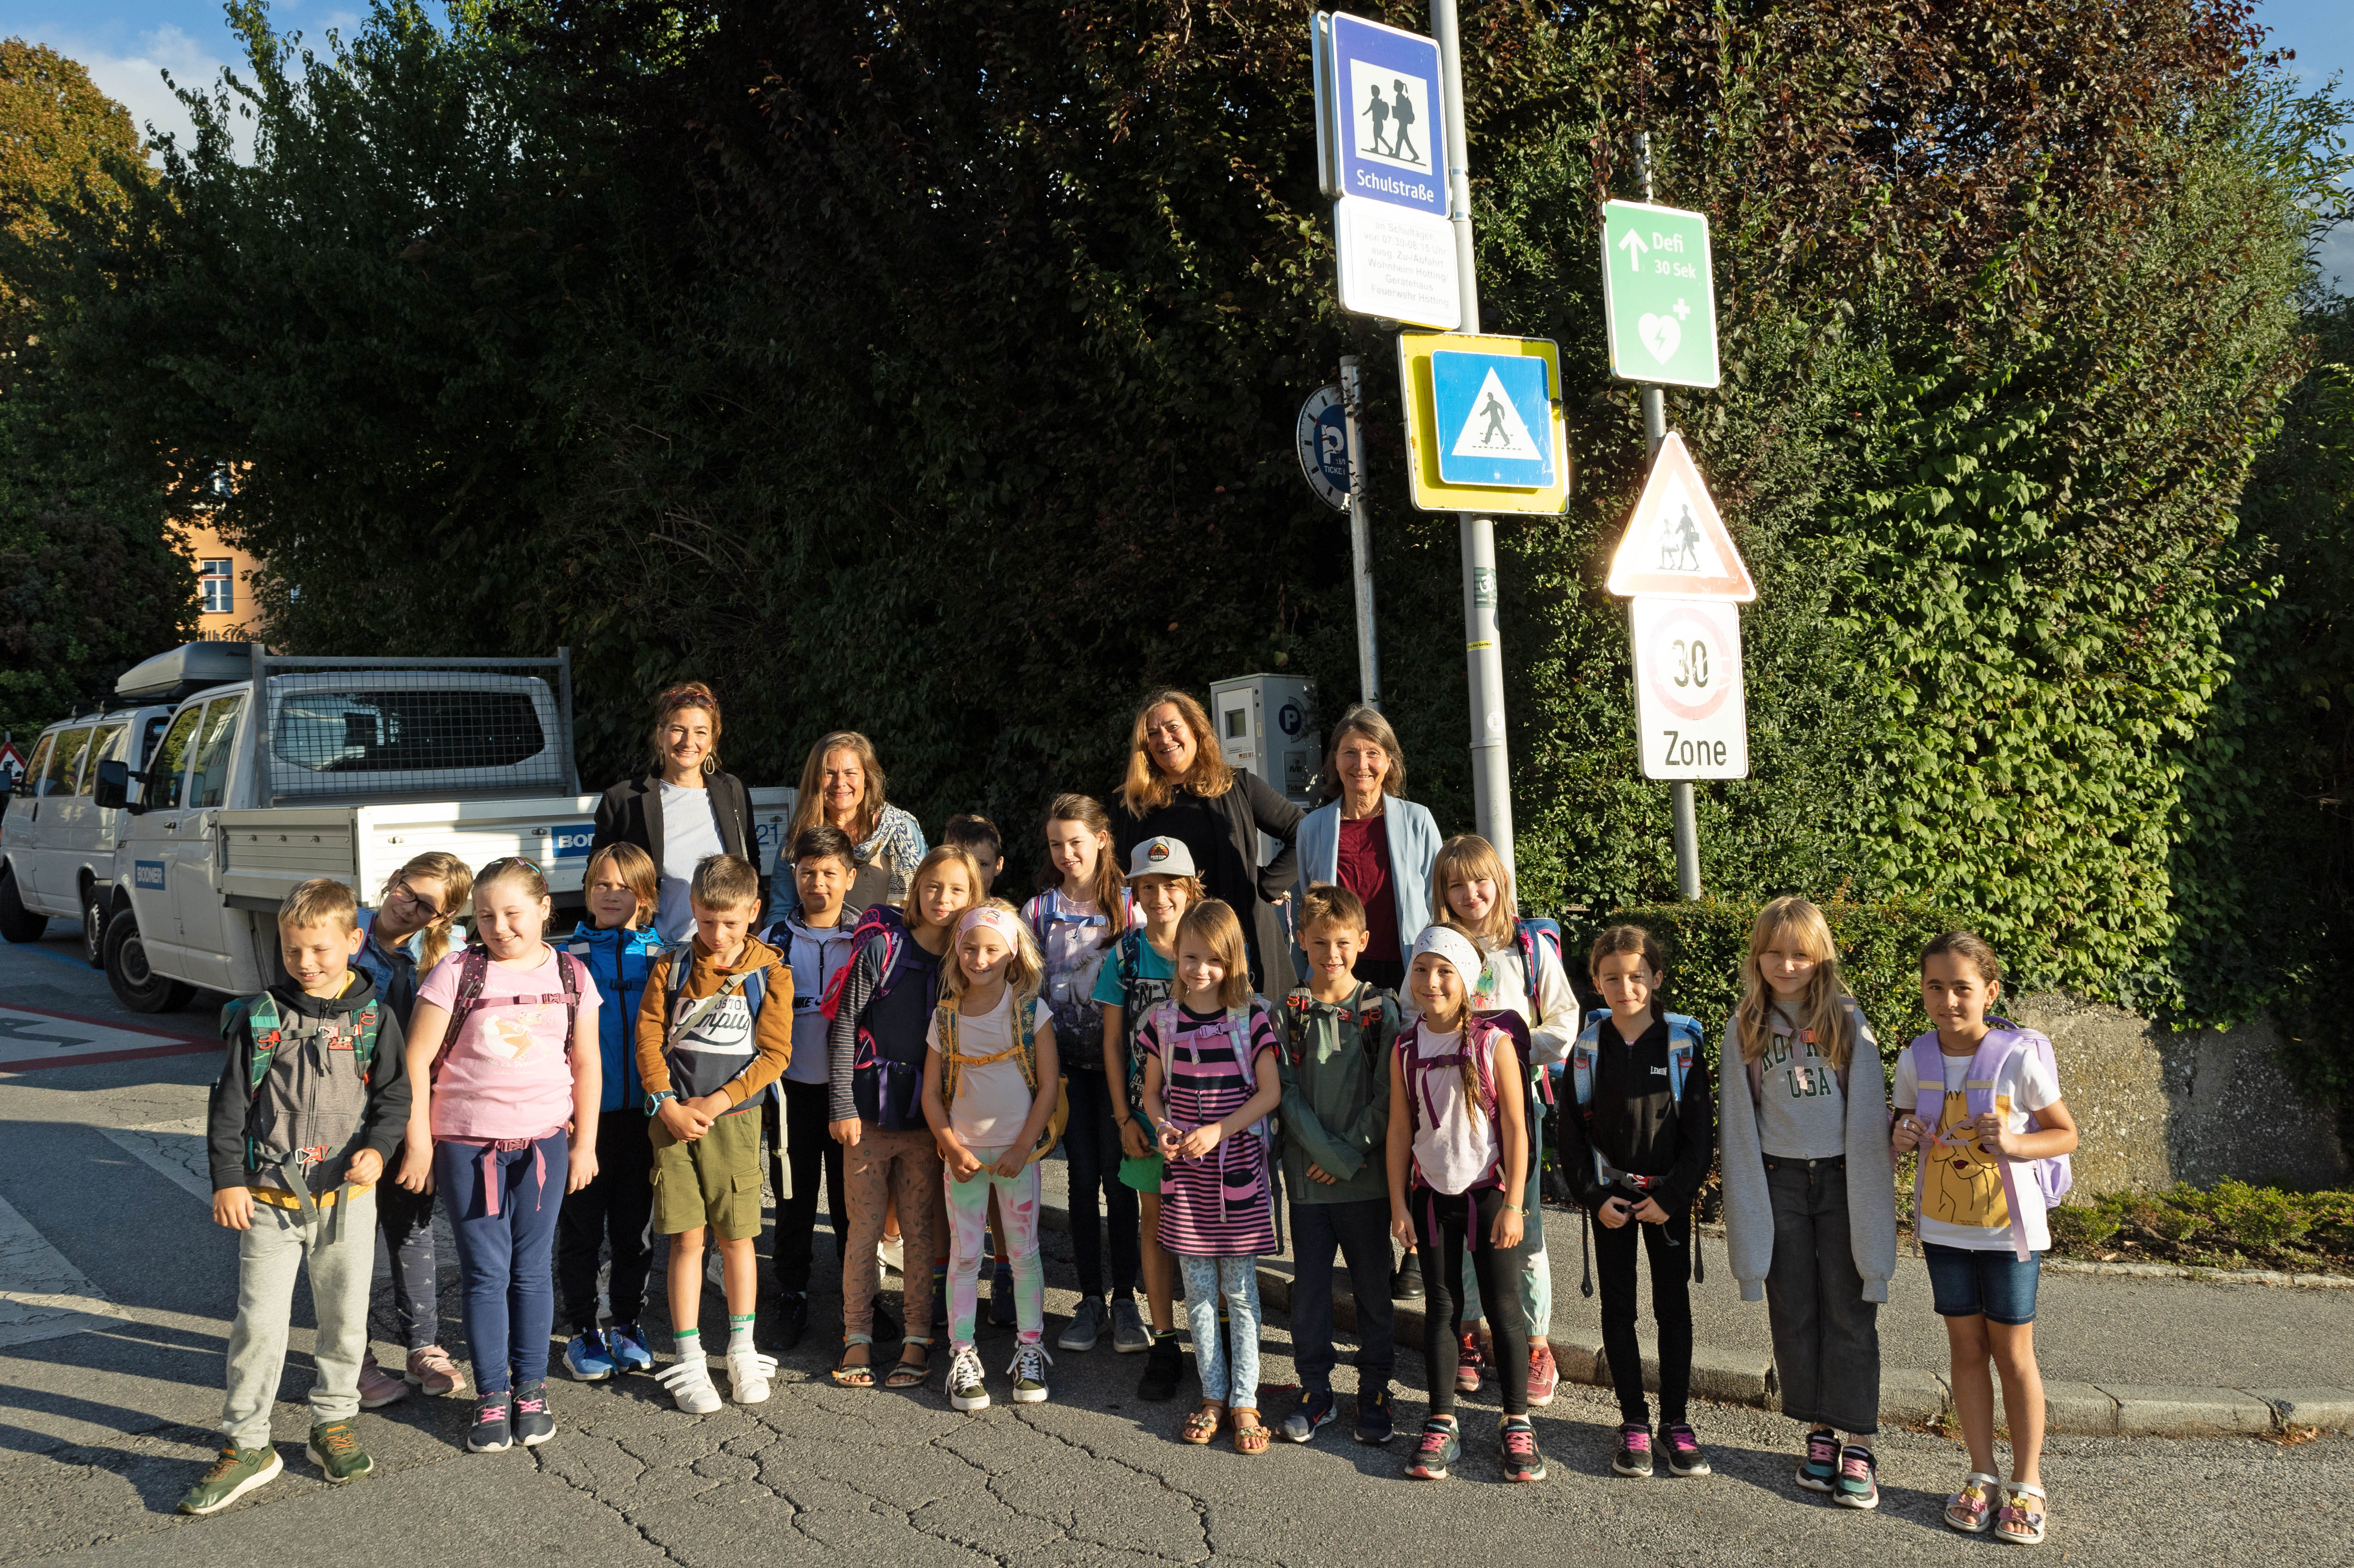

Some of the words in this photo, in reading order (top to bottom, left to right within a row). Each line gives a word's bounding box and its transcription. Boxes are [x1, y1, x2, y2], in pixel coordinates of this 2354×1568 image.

[1357, 168, 1434, 203] Schulstraße
[1375, 221, 1385, 231] an
[1652, 232, 1683, 253] Defi
[1368, 258, 1413, 274] Wohnheim
[1654, 259, 1670, 275] 30
[1673, 262, 1696, 279] Sek
[1371, 284, 1416, 301] Feuerwehr
[1321, 425, 1344, 464] P
[1672, 639, 1708, 688] 30
[1285, 709, 1298, 730] P
[1663, 731, 1726, 766] Zone
[674, 999, 750, 1035] Cmpus
[1650, 1066, 1667, 1076] LEMON
[1786, 1066, 1832, 1099] USA
